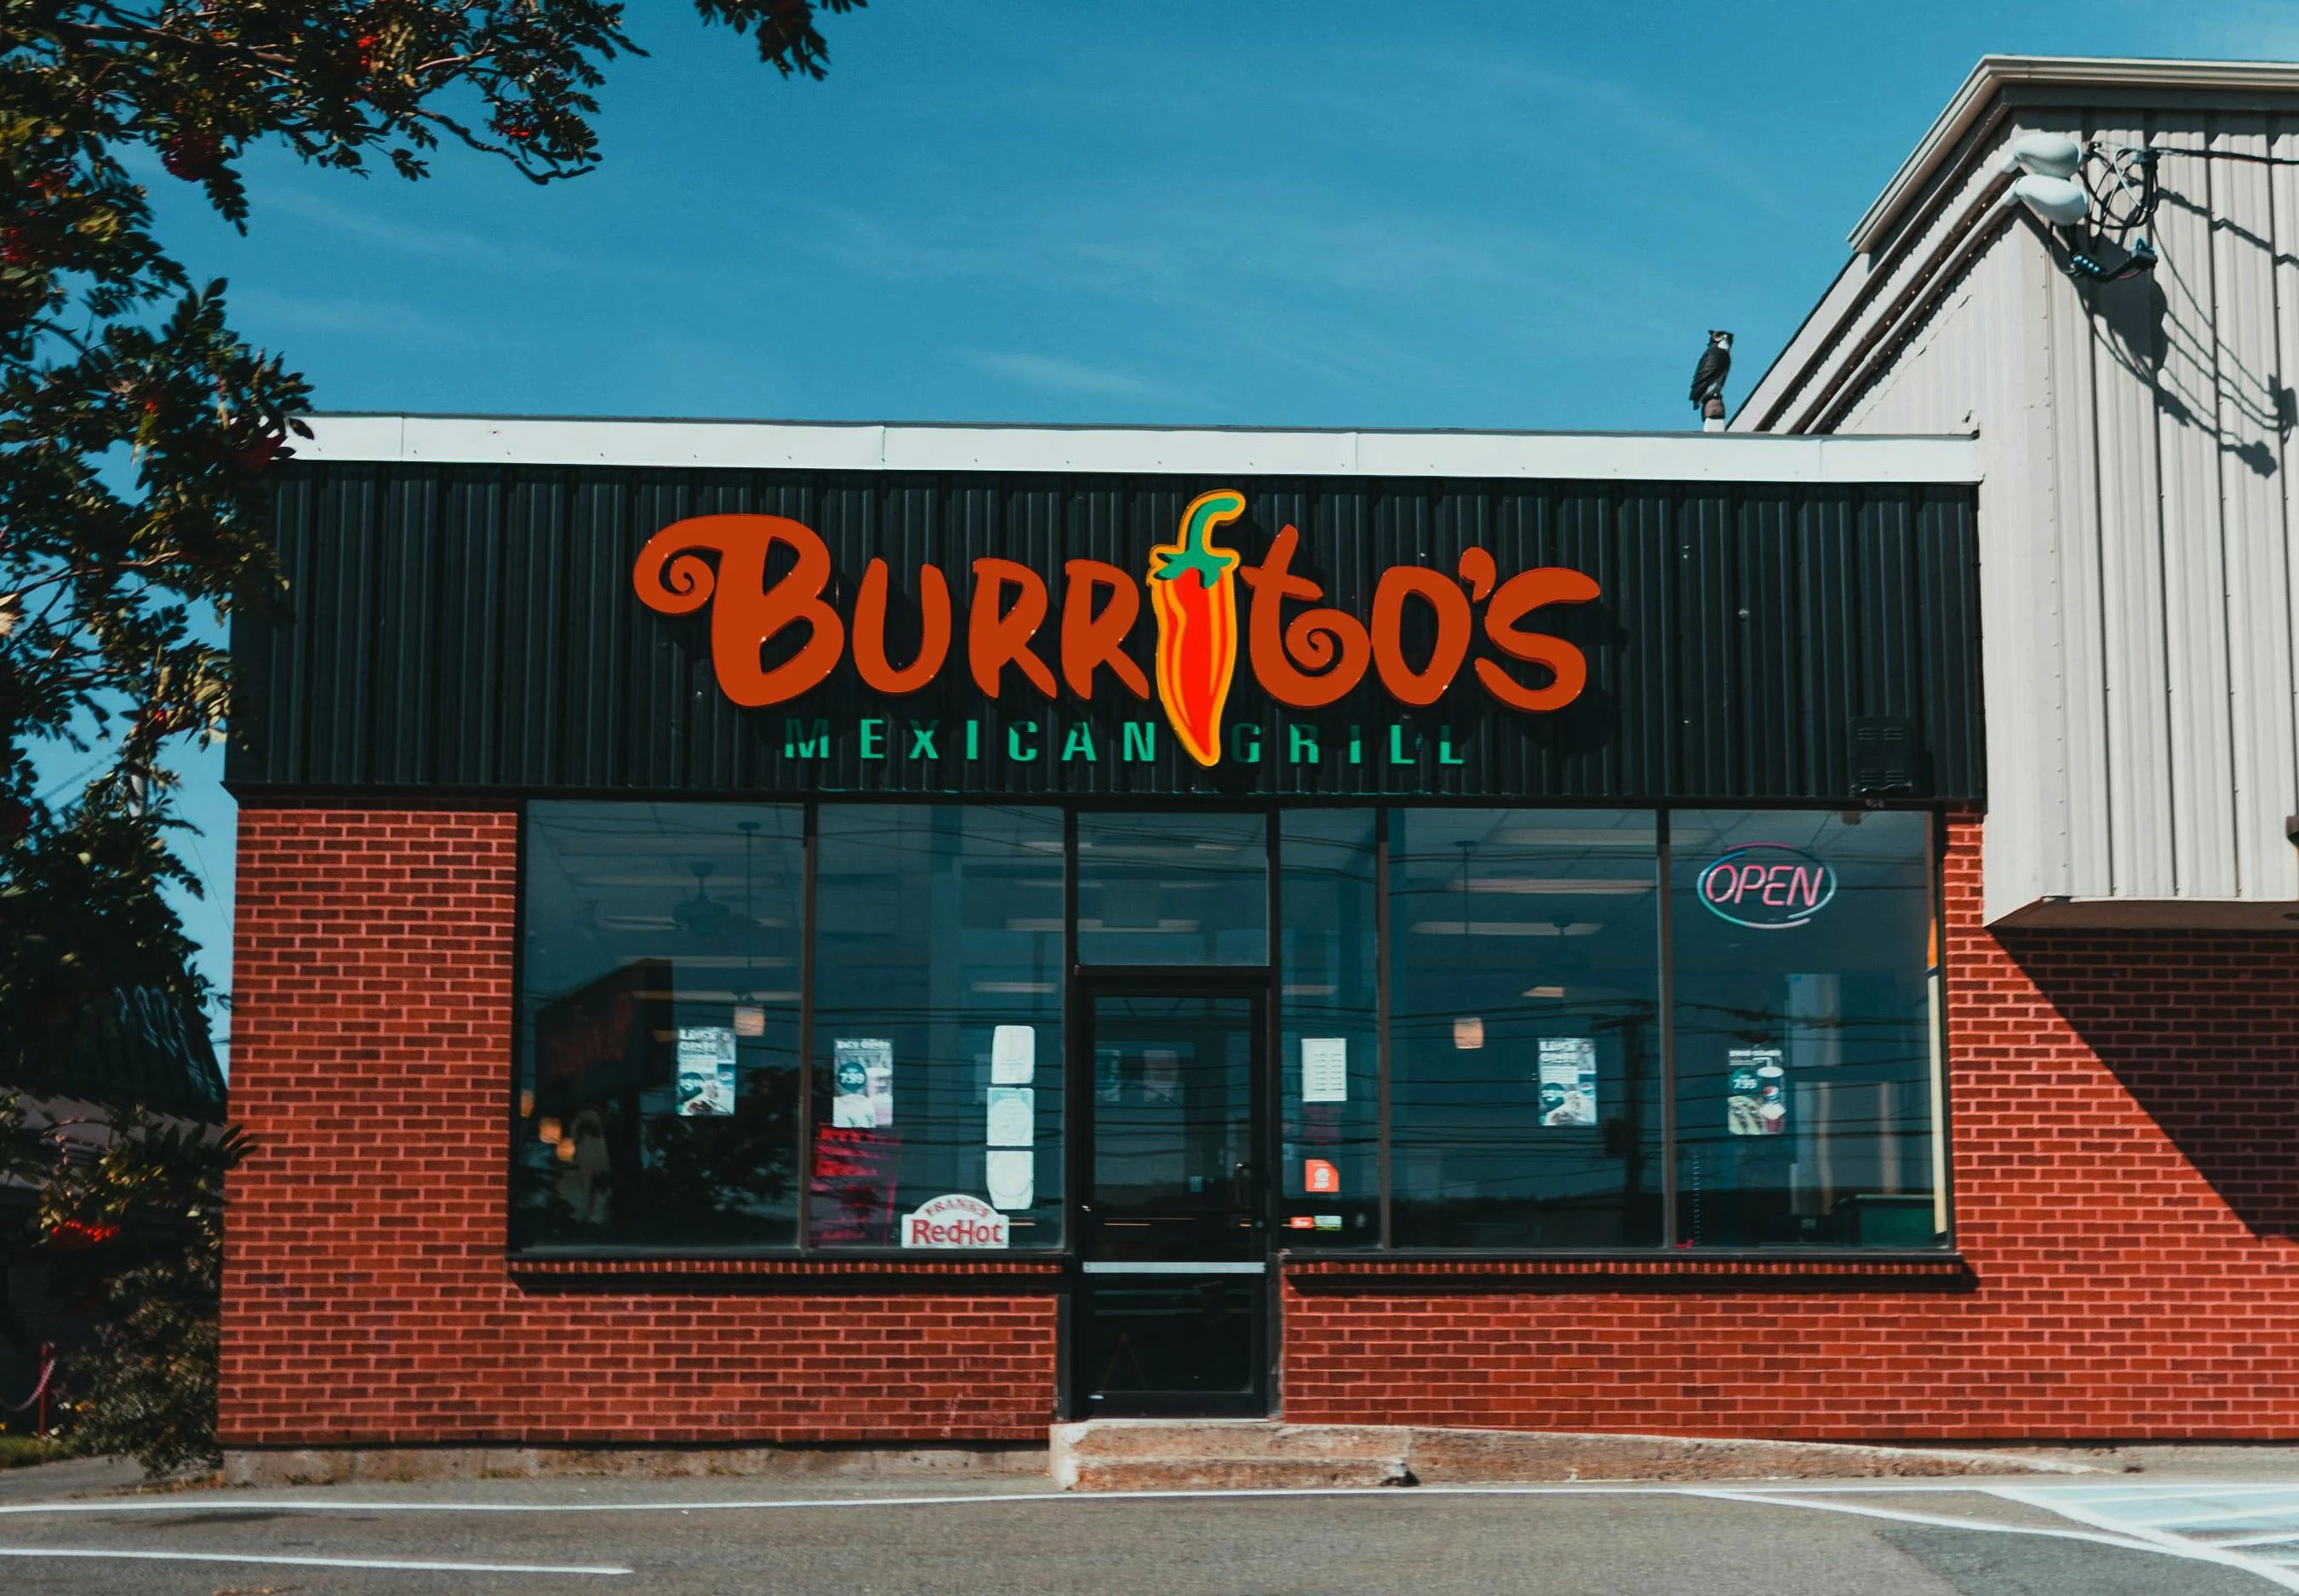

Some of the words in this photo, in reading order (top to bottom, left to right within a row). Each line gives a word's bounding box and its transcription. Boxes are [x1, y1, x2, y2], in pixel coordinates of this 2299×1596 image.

[784, 718, 1155, 761] MEXICAN
[1231, 723, 1465, 764] GRILL
[1706, 864, 1824, 907] OPEN
[912, 1219, 1004, 1244] RedHot
